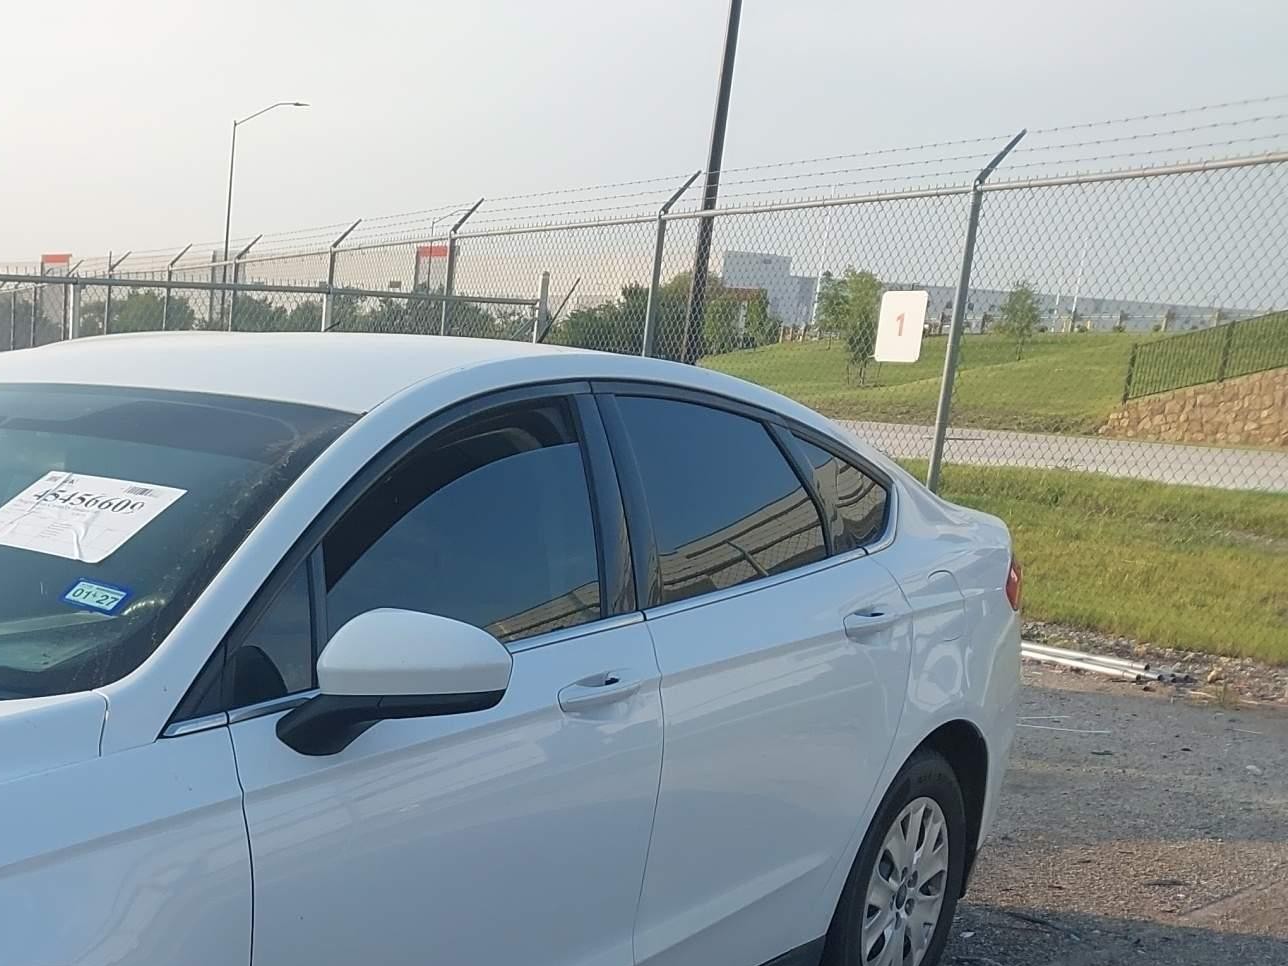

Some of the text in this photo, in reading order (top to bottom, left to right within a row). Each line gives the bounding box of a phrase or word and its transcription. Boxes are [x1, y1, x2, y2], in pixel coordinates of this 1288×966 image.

[895, 311, 905, 337] 1
[33, 488, 145, 515] 45456609
[72, 588, 92, 600] 01
[96, 594, 119, 606] 27
